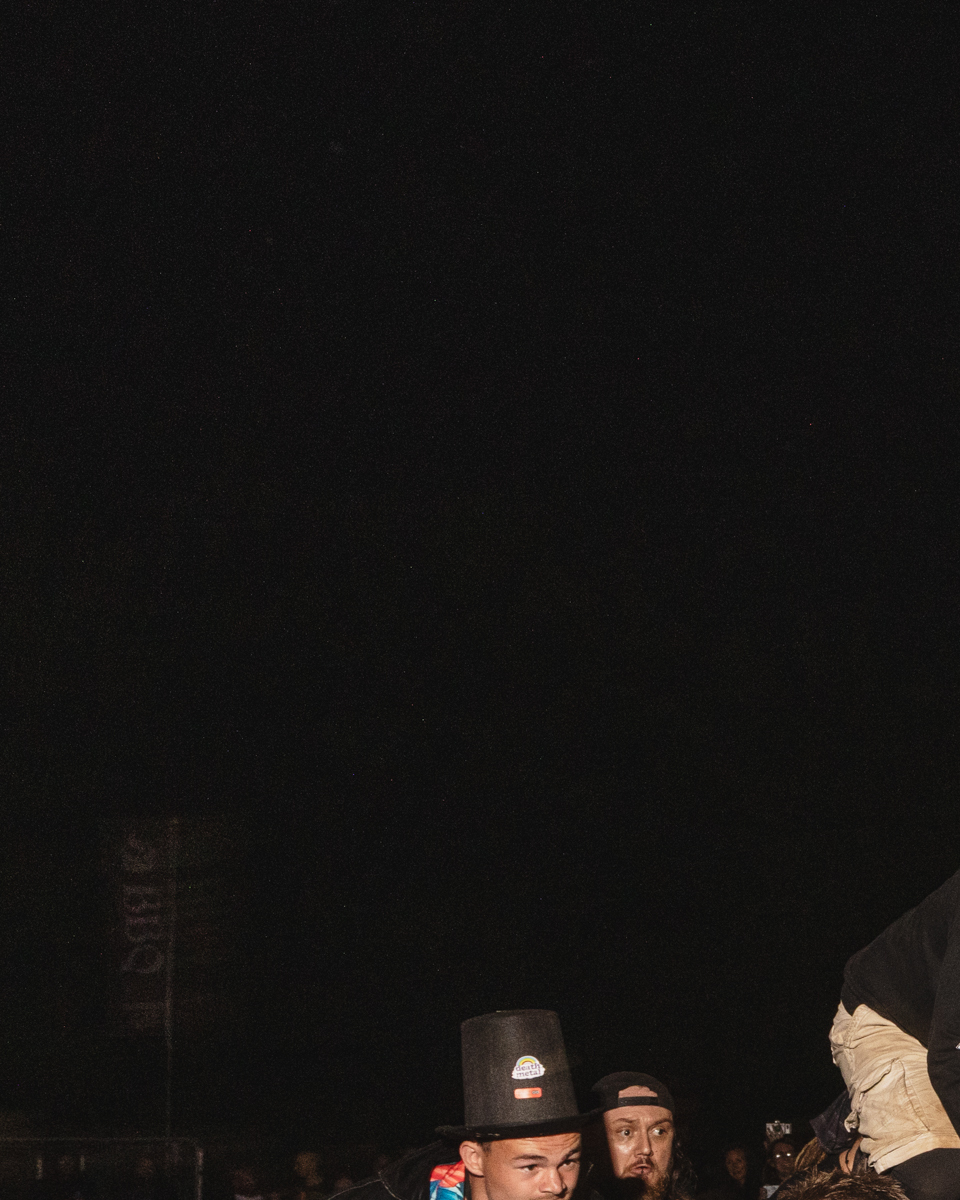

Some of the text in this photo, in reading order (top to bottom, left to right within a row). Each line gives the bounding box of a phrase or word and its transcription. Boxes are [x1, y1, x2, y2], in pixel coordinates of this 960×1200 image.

[121, 885, 164, 974] BBQ
[515, 1063, 541, 1072] death
[516, 1069, 541, 1078] metal
